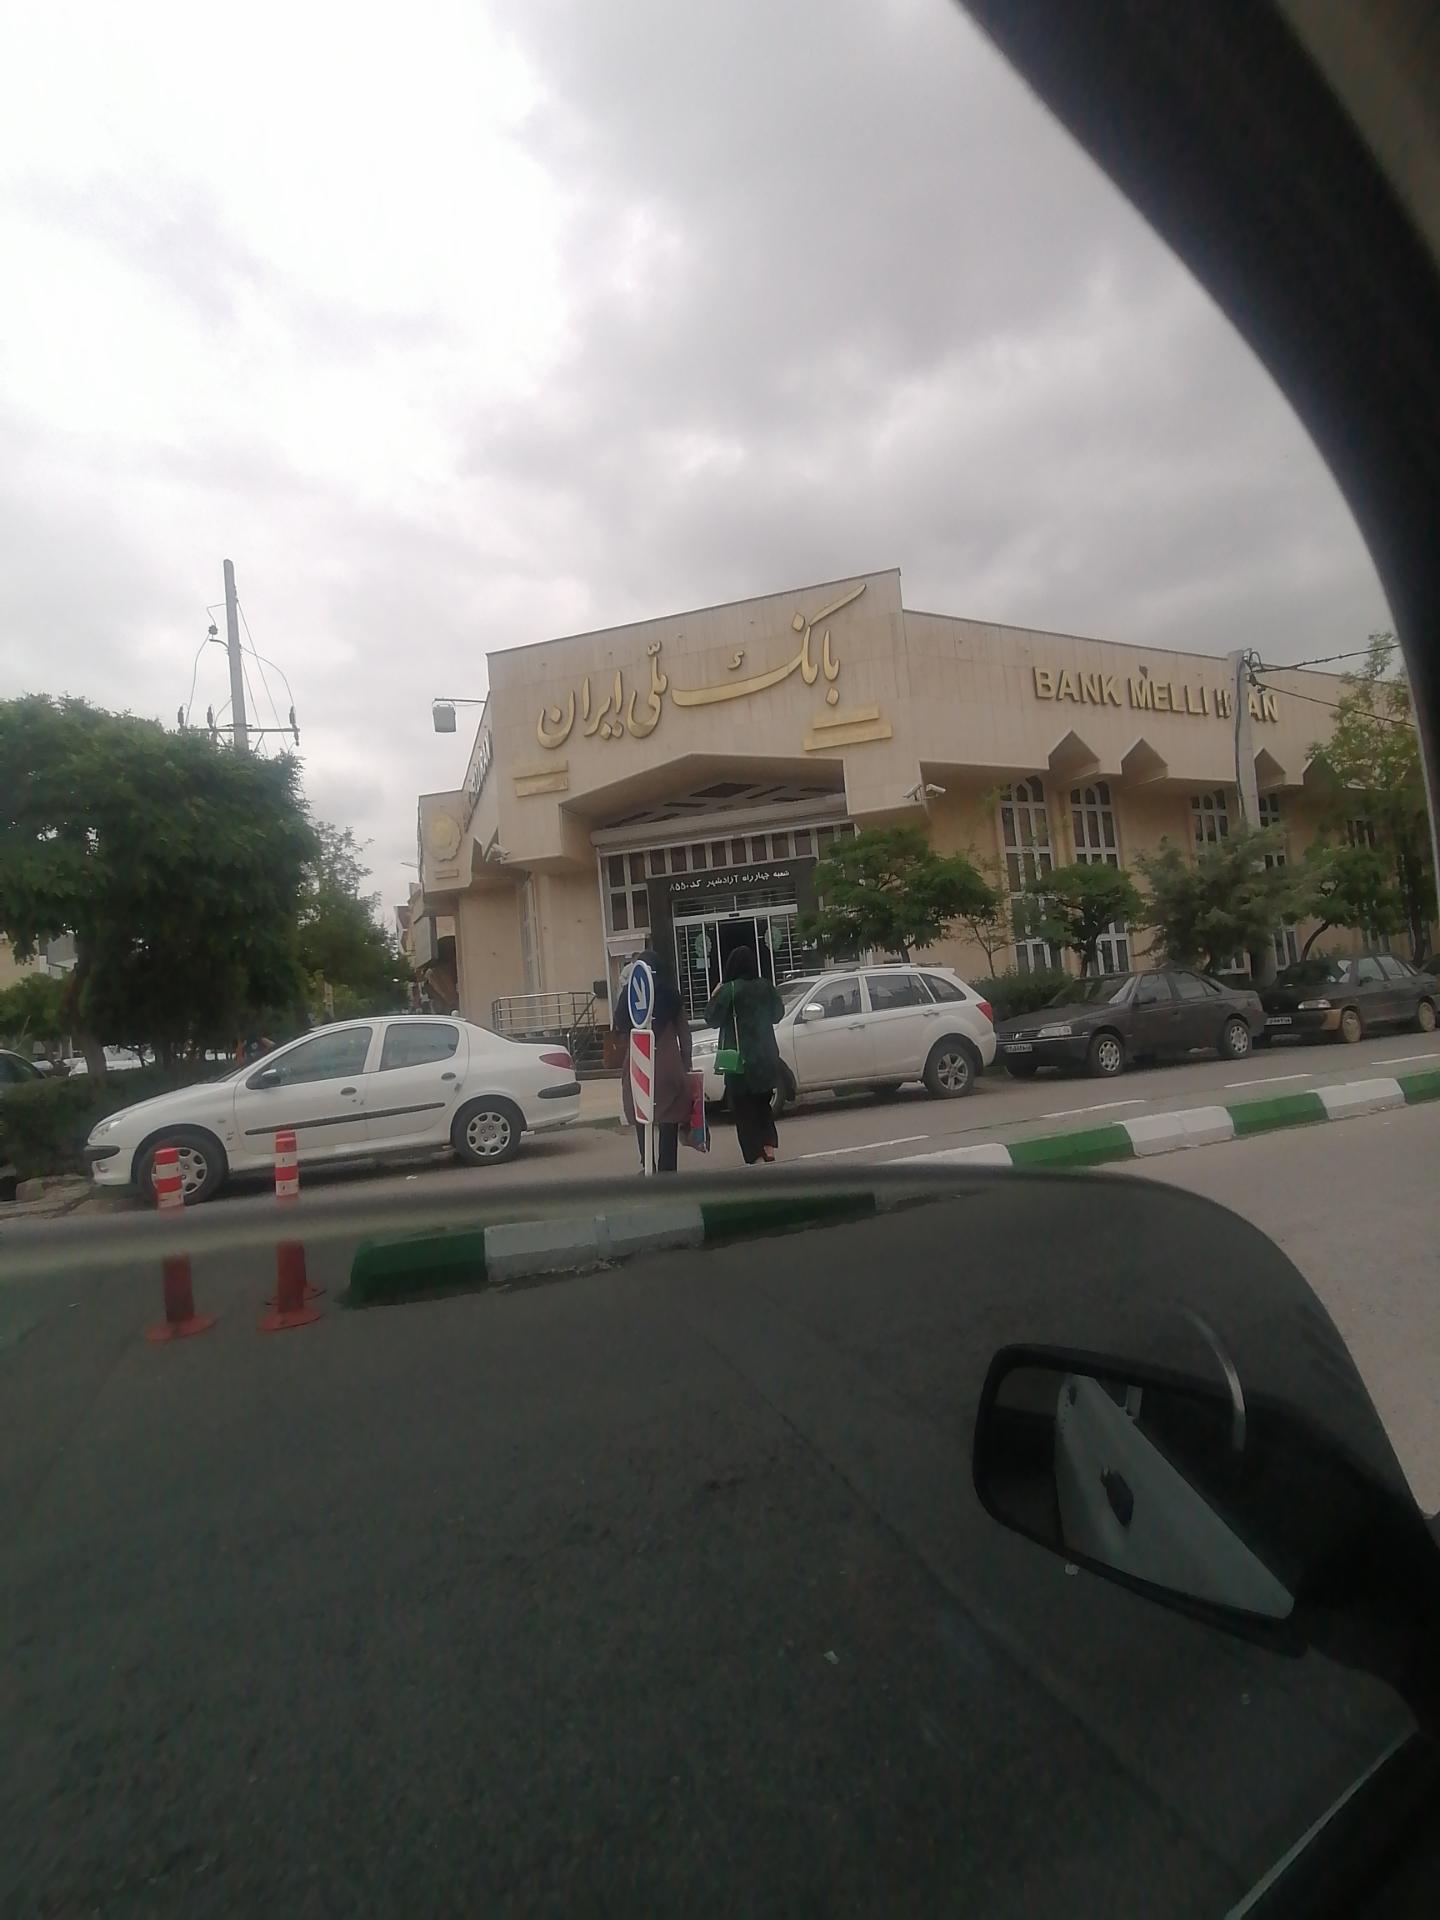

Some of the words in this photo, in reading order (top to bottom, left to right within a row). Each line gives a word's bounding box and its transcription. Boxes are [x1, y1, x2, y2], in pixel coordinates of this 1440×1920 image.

[671, 583, 867, 707] بانک
[536, 669, 624, 749] ایران
[1033, 667, 1121, 706] BANK
[1128, 678, 1209, 717] MELLI
[773, 870, 790, 879] شعبه
